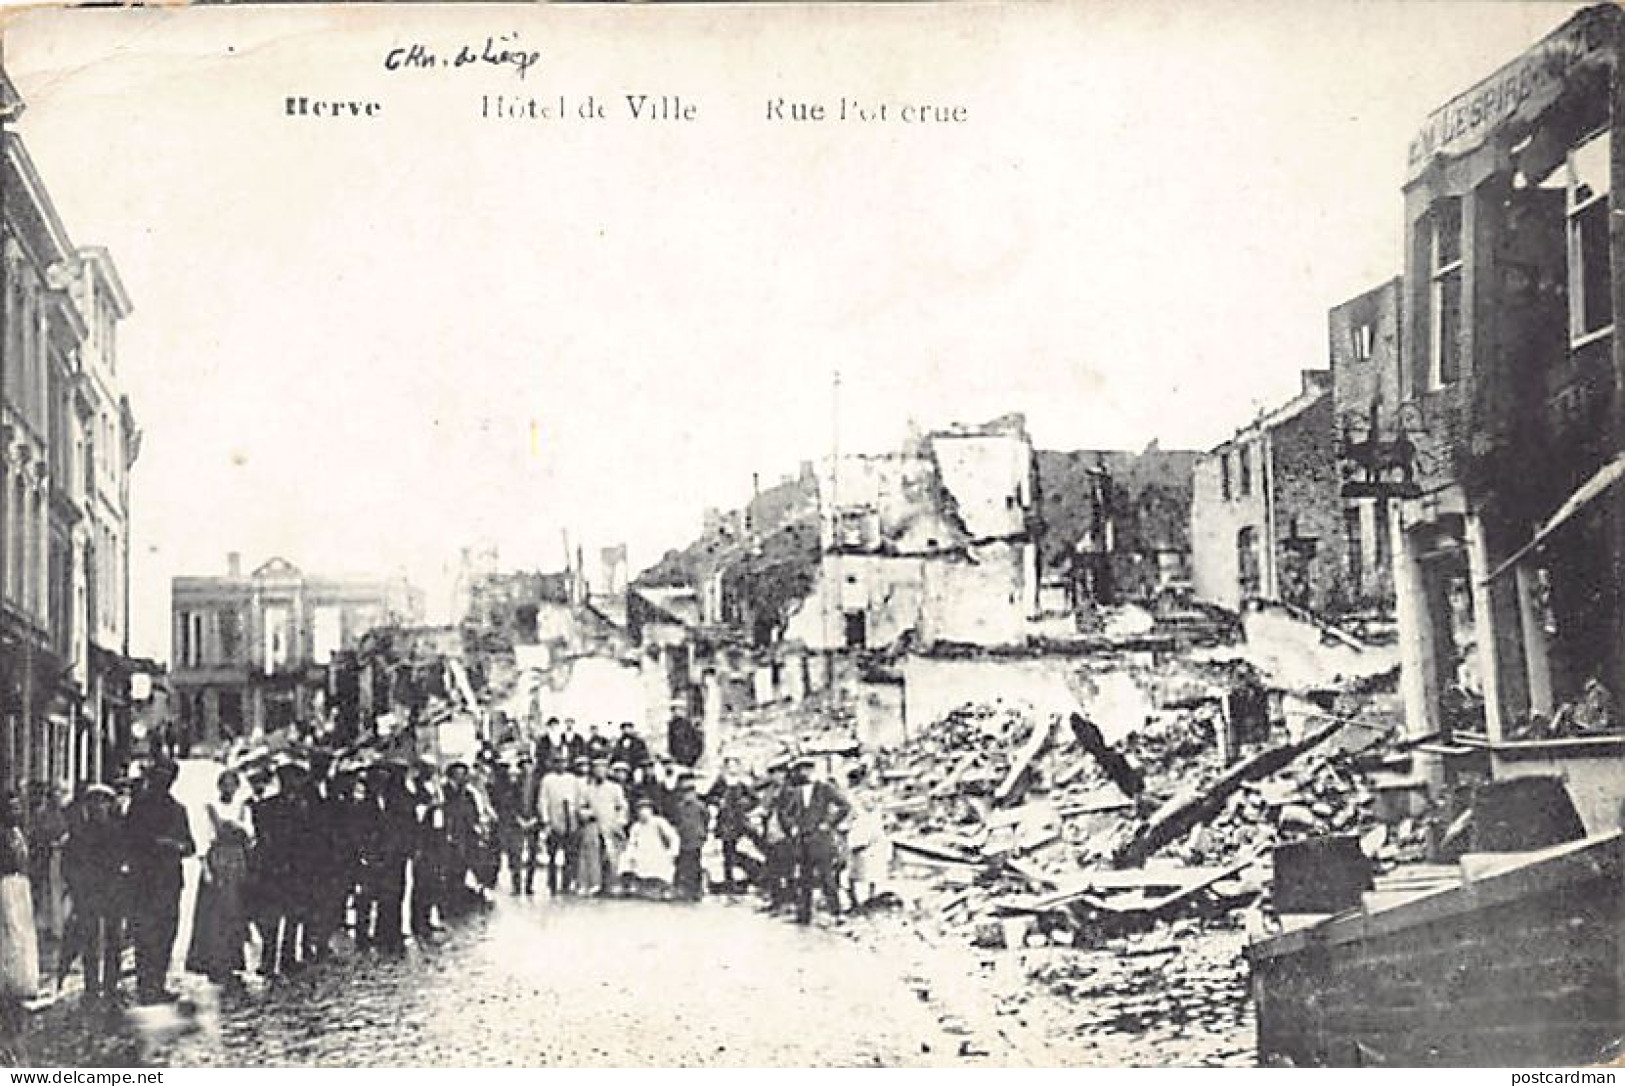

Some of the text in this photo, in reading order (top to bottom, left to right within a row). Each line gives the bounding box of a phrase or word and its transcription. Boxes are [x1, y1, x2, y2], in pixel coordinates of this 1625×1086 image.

[285, 97, 382, 117] Herve
[482, 95, 697, 121] Hôtel de Ville
[766, 98, 825, 121] Rue
